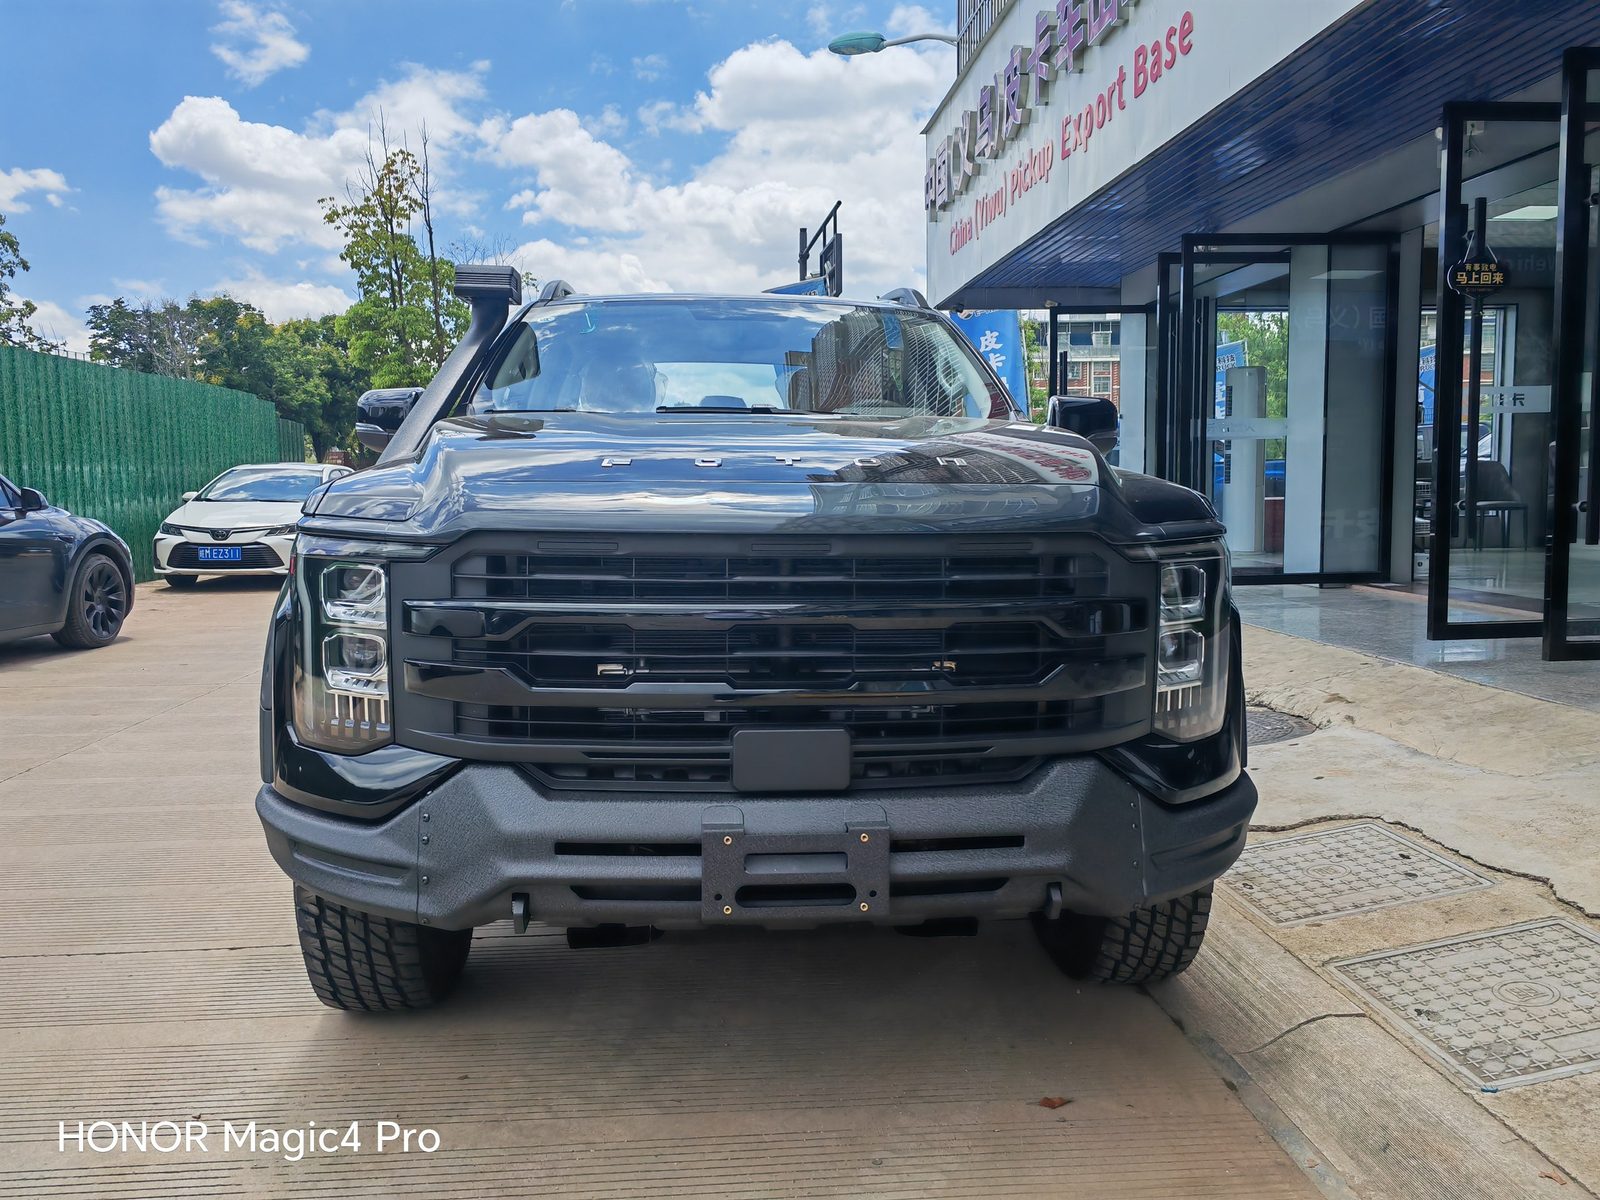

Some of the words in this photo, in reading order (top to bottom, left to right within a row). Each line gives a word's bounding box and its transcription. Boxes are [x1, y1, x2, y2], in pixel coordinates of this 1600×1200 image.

[949, 221, 973, 256] China
[975, 171, 1007, 240] (Yiwu)
[1009, 137, 1054, 206] Pickup
[1060, 66, 1126, 161] Export
[1133, 10, 1194, 98] Base
[1456, 272, 1504, 284] 马上回来
[980, 330, 1009, 389] 皮卡
